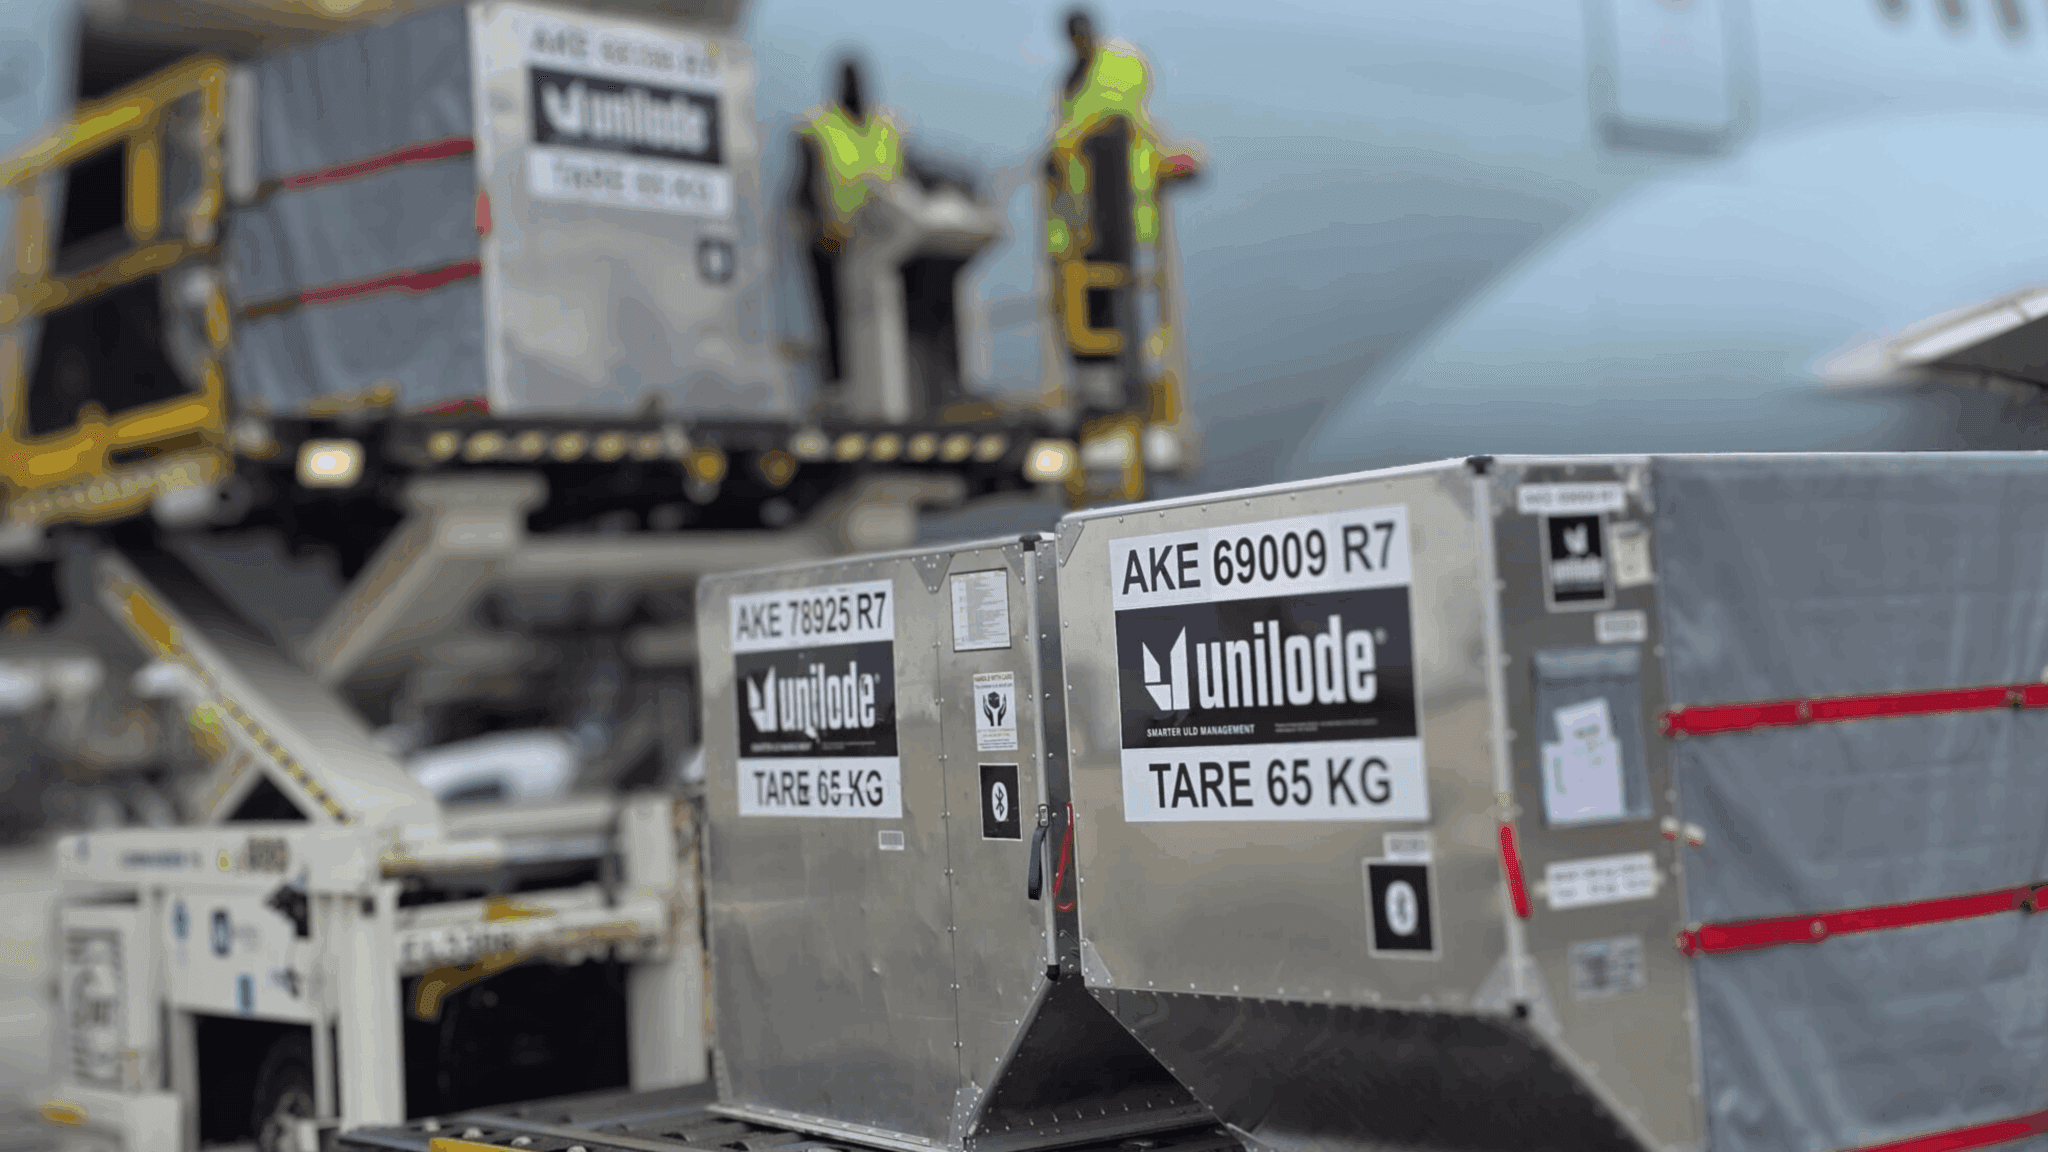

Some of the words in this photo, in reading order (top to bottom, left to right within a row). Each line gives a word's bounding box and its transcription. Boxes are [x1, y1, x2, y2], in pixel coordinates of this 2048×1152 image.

[1122, 542, 1201, 595] AKE
[1213, 529, 1327, 586] 69009
[1342, 521, 1395, 572] R7
[737, 602, 782, 640] AKE
[788, 596, 850, 637] 78925
[857, 591, 887, 630] R7
[1195, 614, 1378, 710] unilode
[778, 660, 877, 732] unilode
[1146, 728, 1182, 738] SMARTER
[1183, 726, 1199, 736] ULD
[1200, 723, 1256, 736] MANAGEMENT
[754, 770, 810, 806] TARE
[818, 770, 842, 806] 65
[849, 769, 884, 807] KG
[1149, 760, 1254, 808] TARE
[1267, 758, 1312, 806] 65
[1326, 756, 1392, 805] KG
